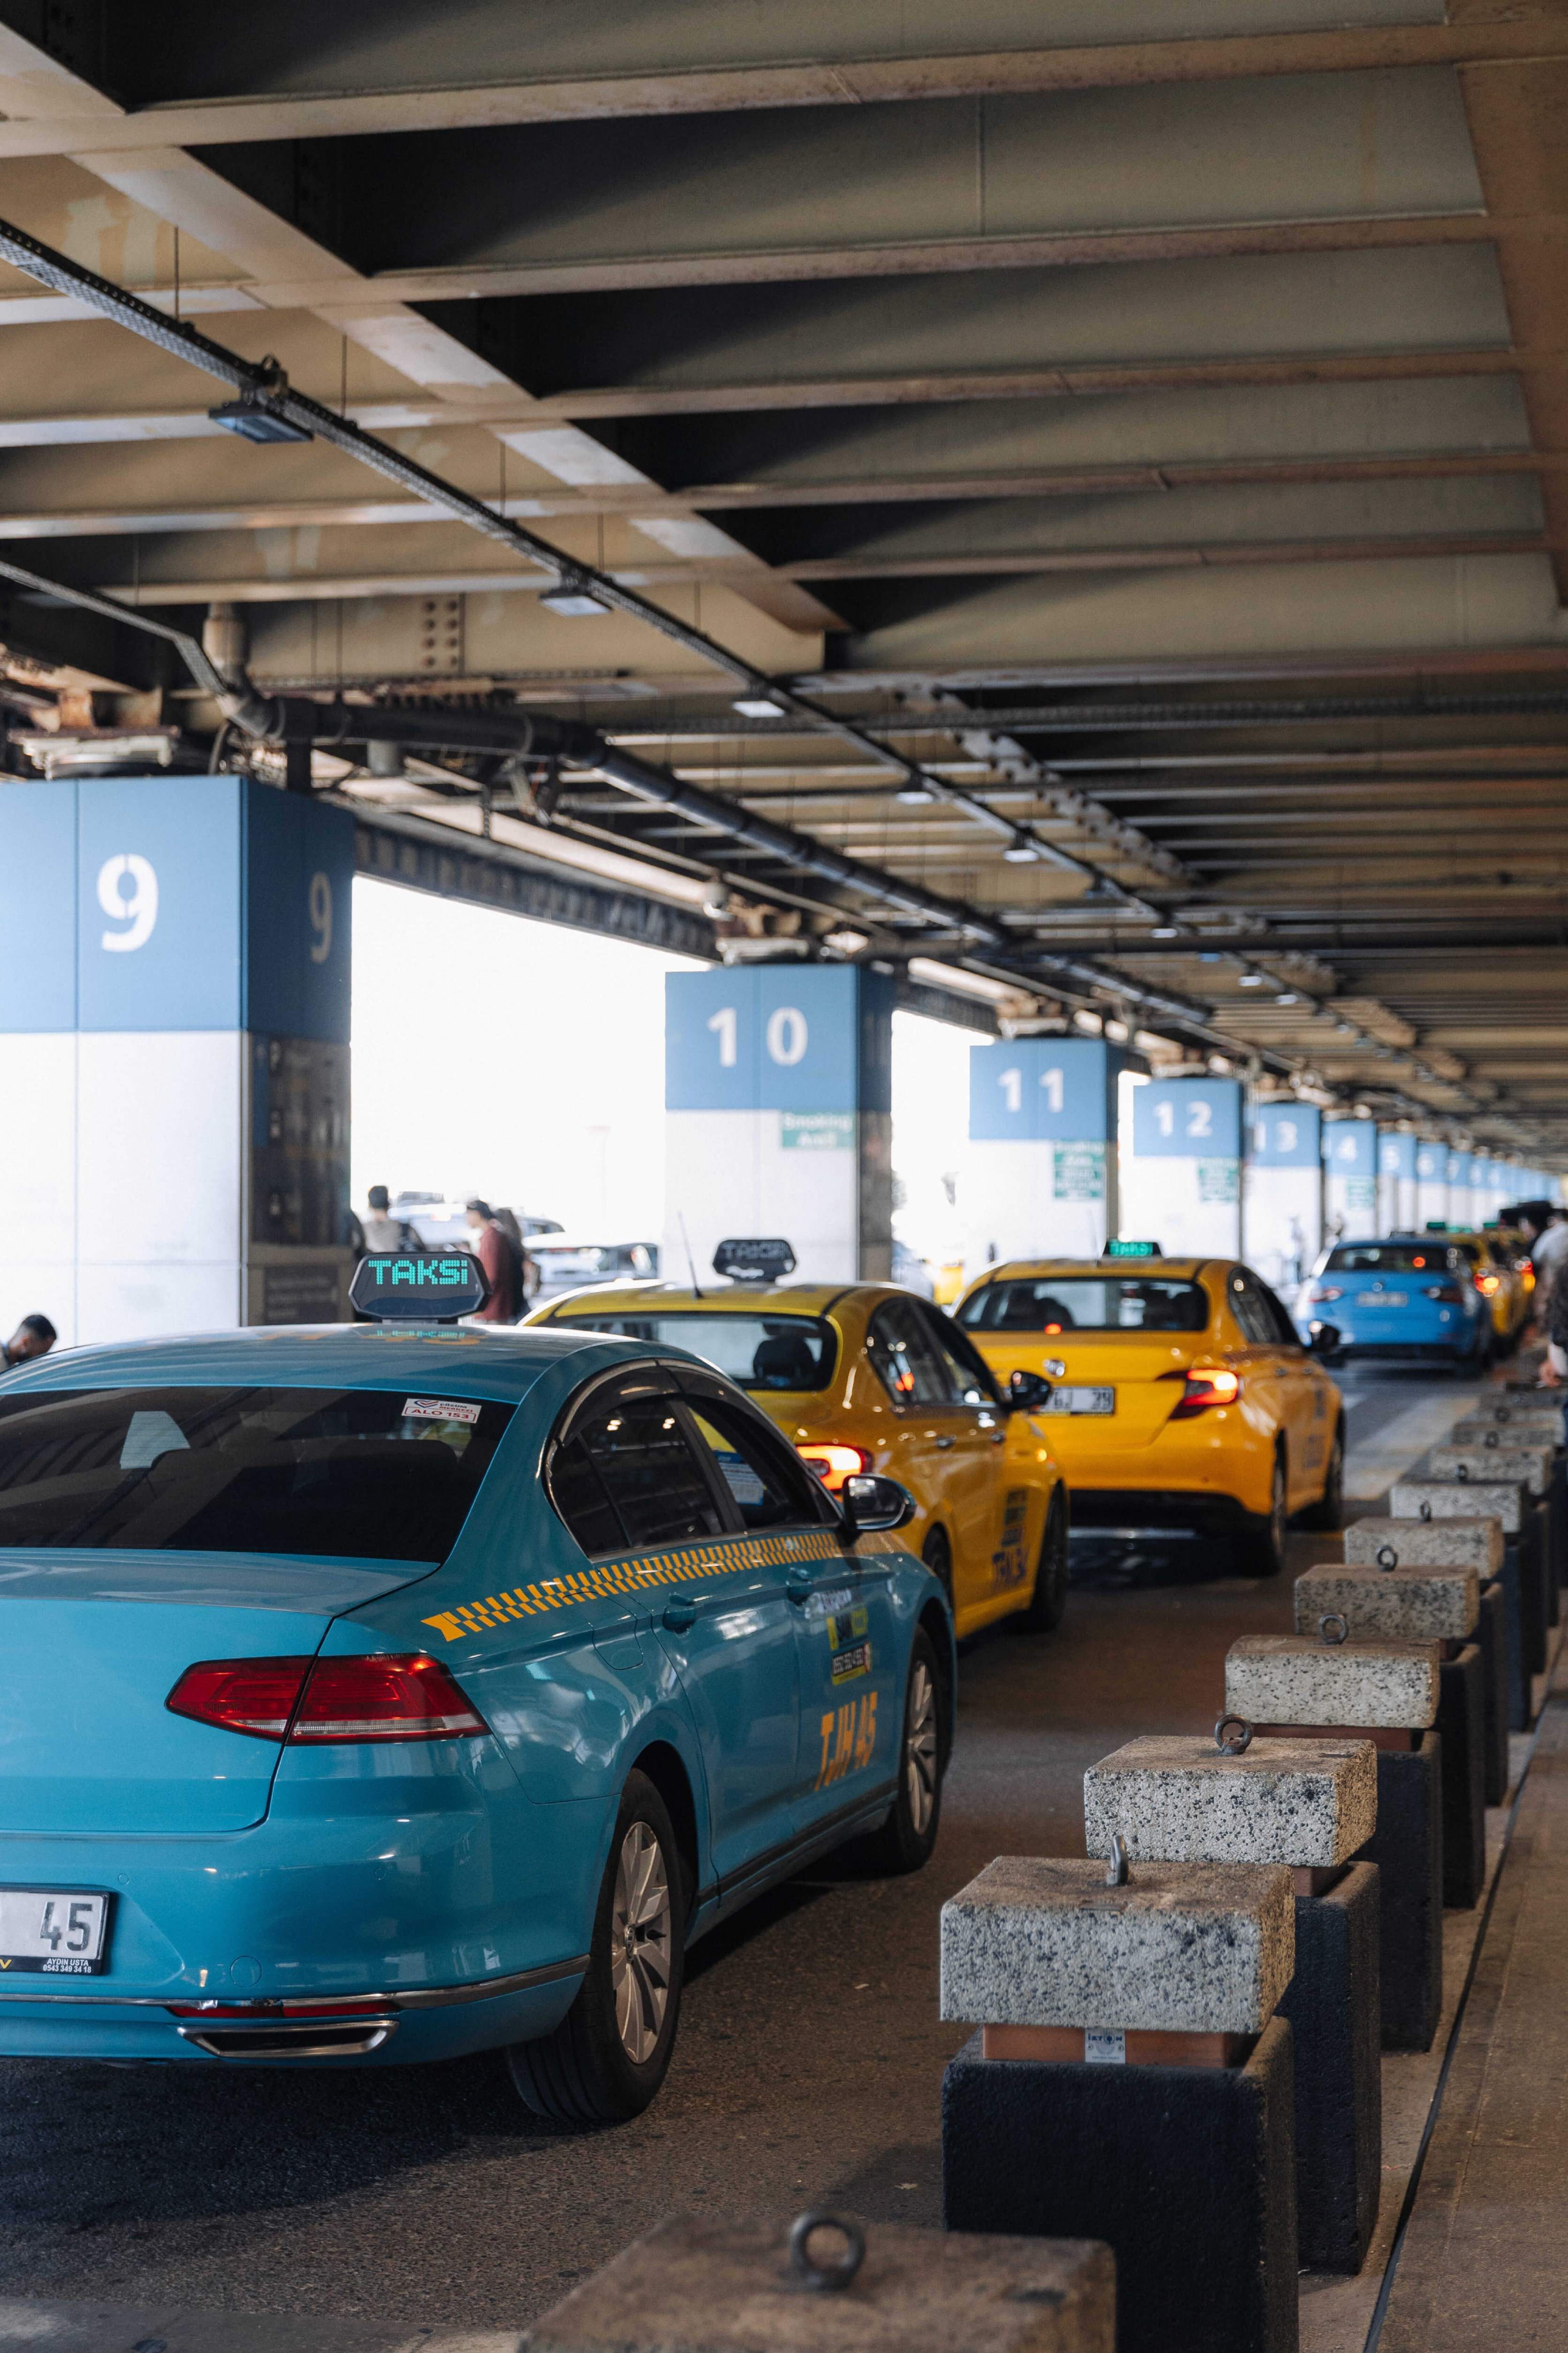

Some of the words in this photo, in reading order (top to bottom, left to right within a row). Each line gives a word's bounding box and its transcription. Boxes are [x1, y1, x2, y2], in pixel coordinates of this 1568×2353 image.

[97, 853, 159, 953] 9
[309, 872, 332, 964] 9
[39, 1901, 93, 1952] 45
